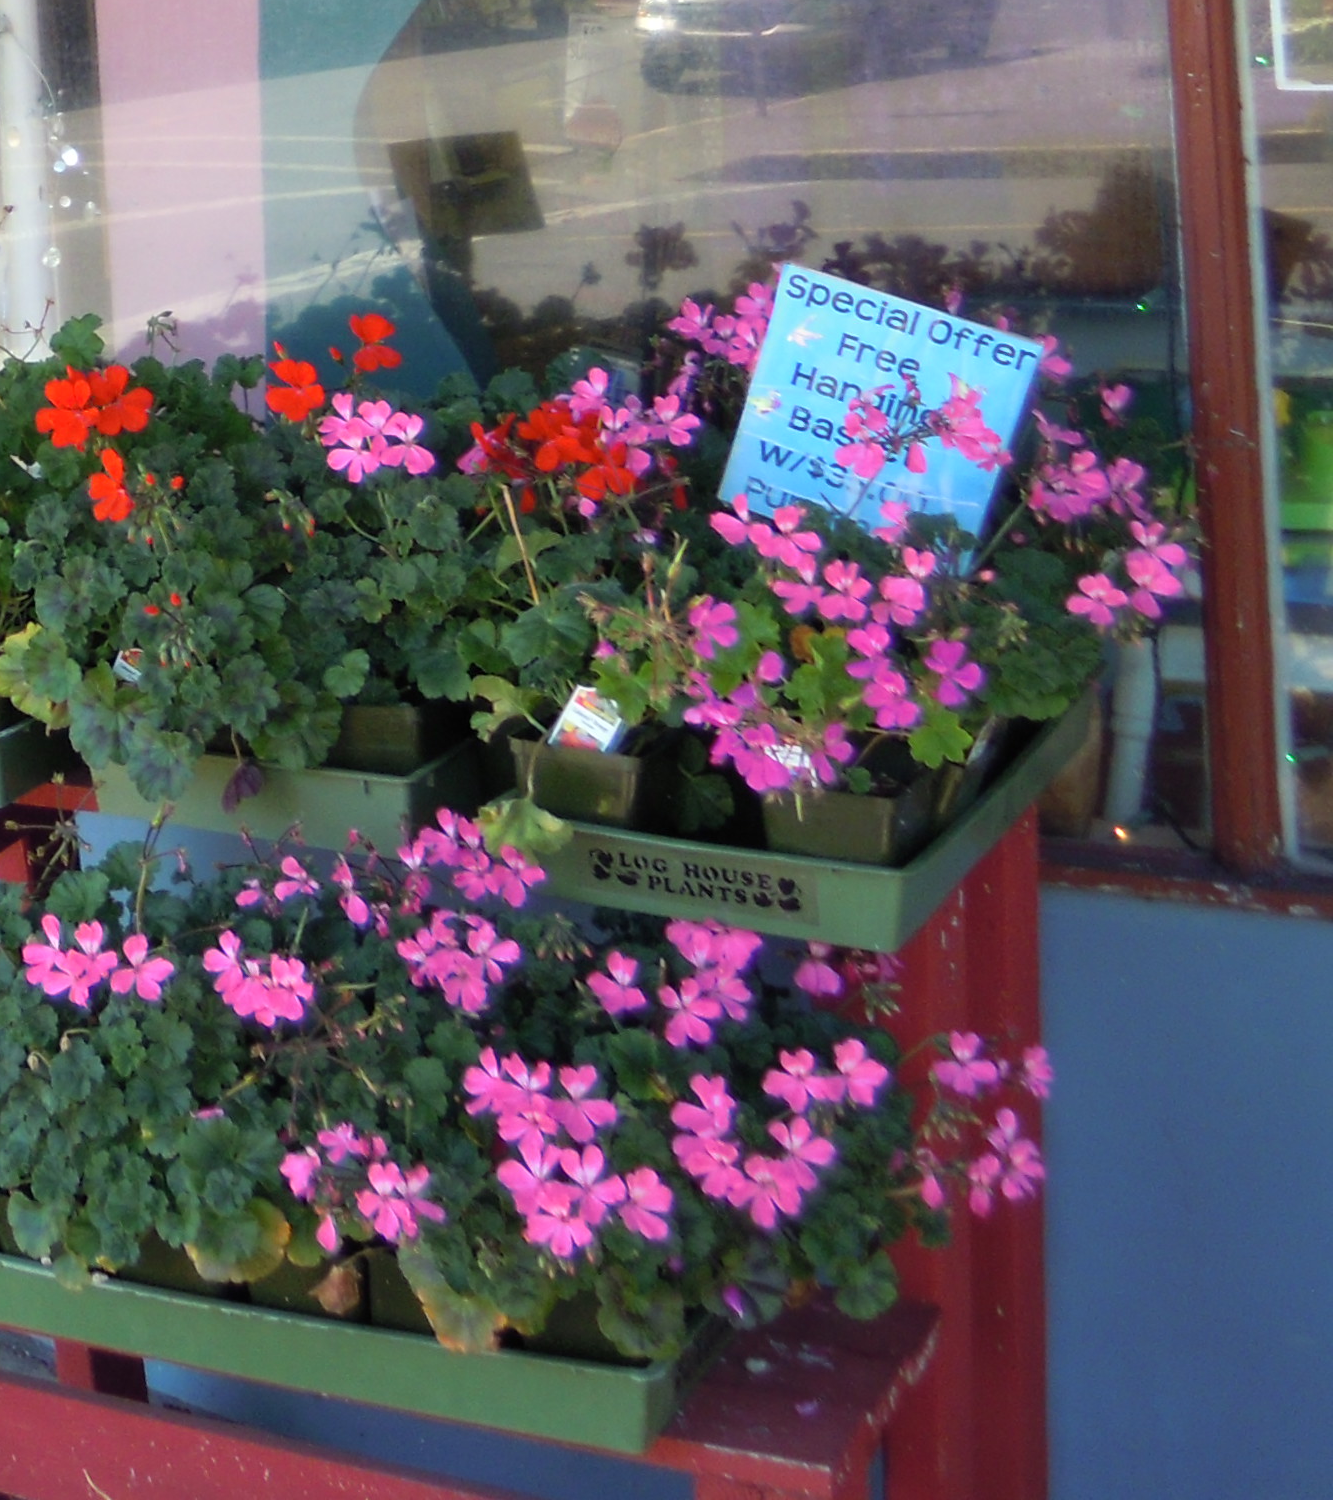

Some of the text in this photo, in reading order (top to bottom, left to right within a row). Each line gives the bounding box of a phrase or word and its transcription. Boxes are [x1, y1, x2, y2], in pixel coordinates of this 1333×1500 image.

[835, 332, 921, 378] Free
[927, 318, 1039, 371] Offer
[619, 852, 772, 890] LOG HOUSE
[648, 874, 748, 905] PLANTS
